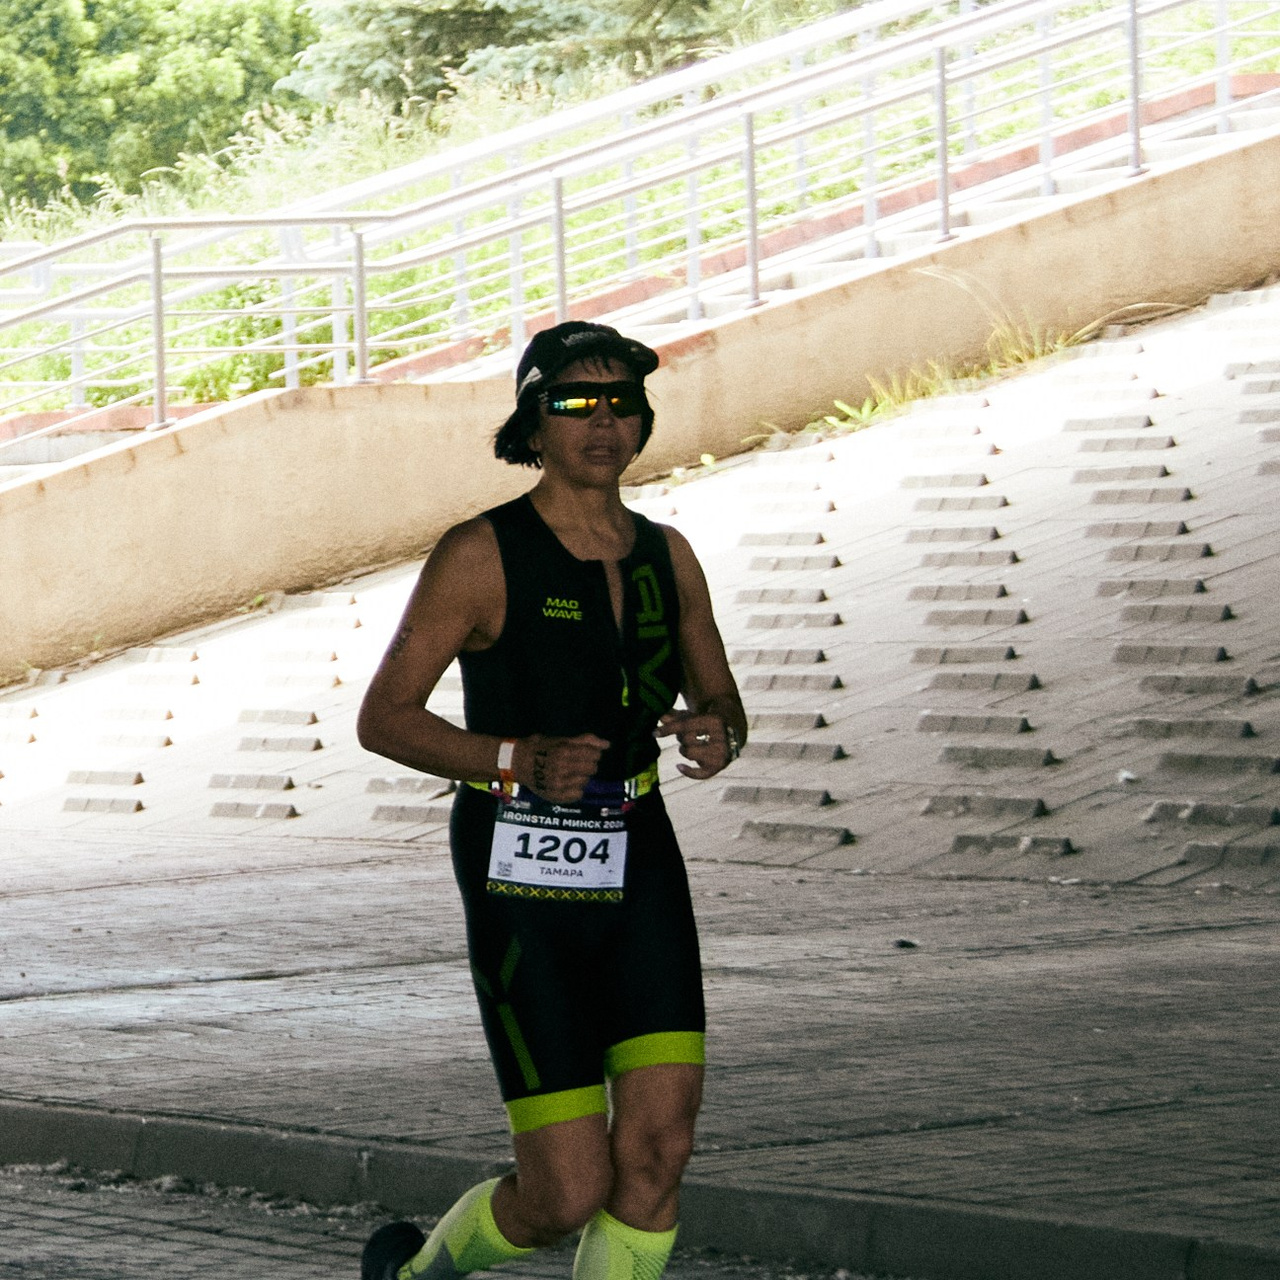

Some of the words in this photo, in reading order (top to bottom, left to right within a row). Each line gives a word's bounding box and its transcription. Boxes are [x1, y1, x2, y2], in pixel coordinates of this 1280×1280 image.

[546, 597, 579, 608] MAD
[542, 607, 583, 620] WAVE
[503, 810, 560, 826] IRONSTAR
[562, 818, 602, 829] МИНСК
[514, 832, 610, 864] 1204
[539, 867, 584, 877] ТАМАРА
